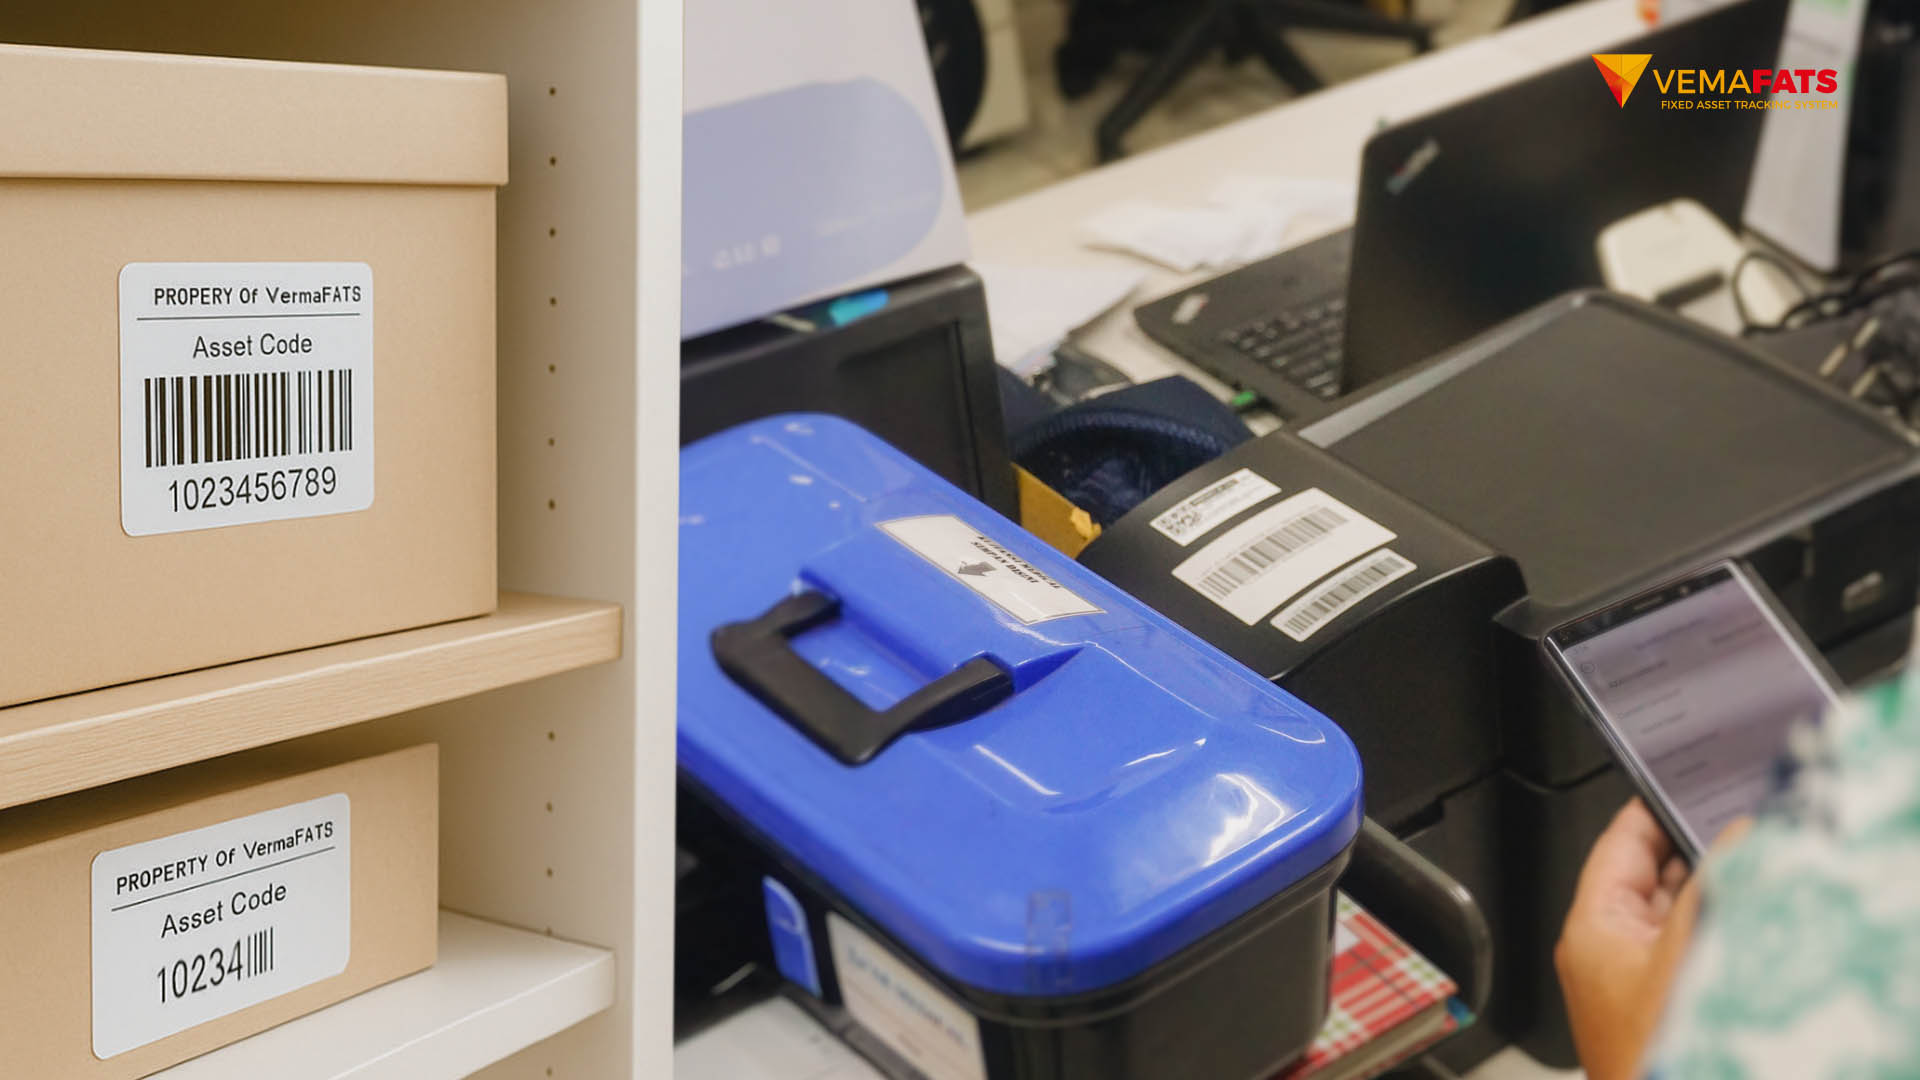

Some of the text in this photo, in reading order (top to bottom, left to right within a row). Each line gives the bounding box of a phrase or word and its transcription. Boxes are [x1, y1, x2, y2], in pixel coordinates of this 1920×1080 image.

[154, 285, 361, 306] PROPERY Of VermaFATS
[193, 333, 313, 359] Asset Code
[168, 465, 337, 513] 1023456789
[116, 820, 334, 896] PROPERTY Of VermaFATS
[160, 883, 287, 939] Asset Code
[156, 939, 243, 1004] 10234
